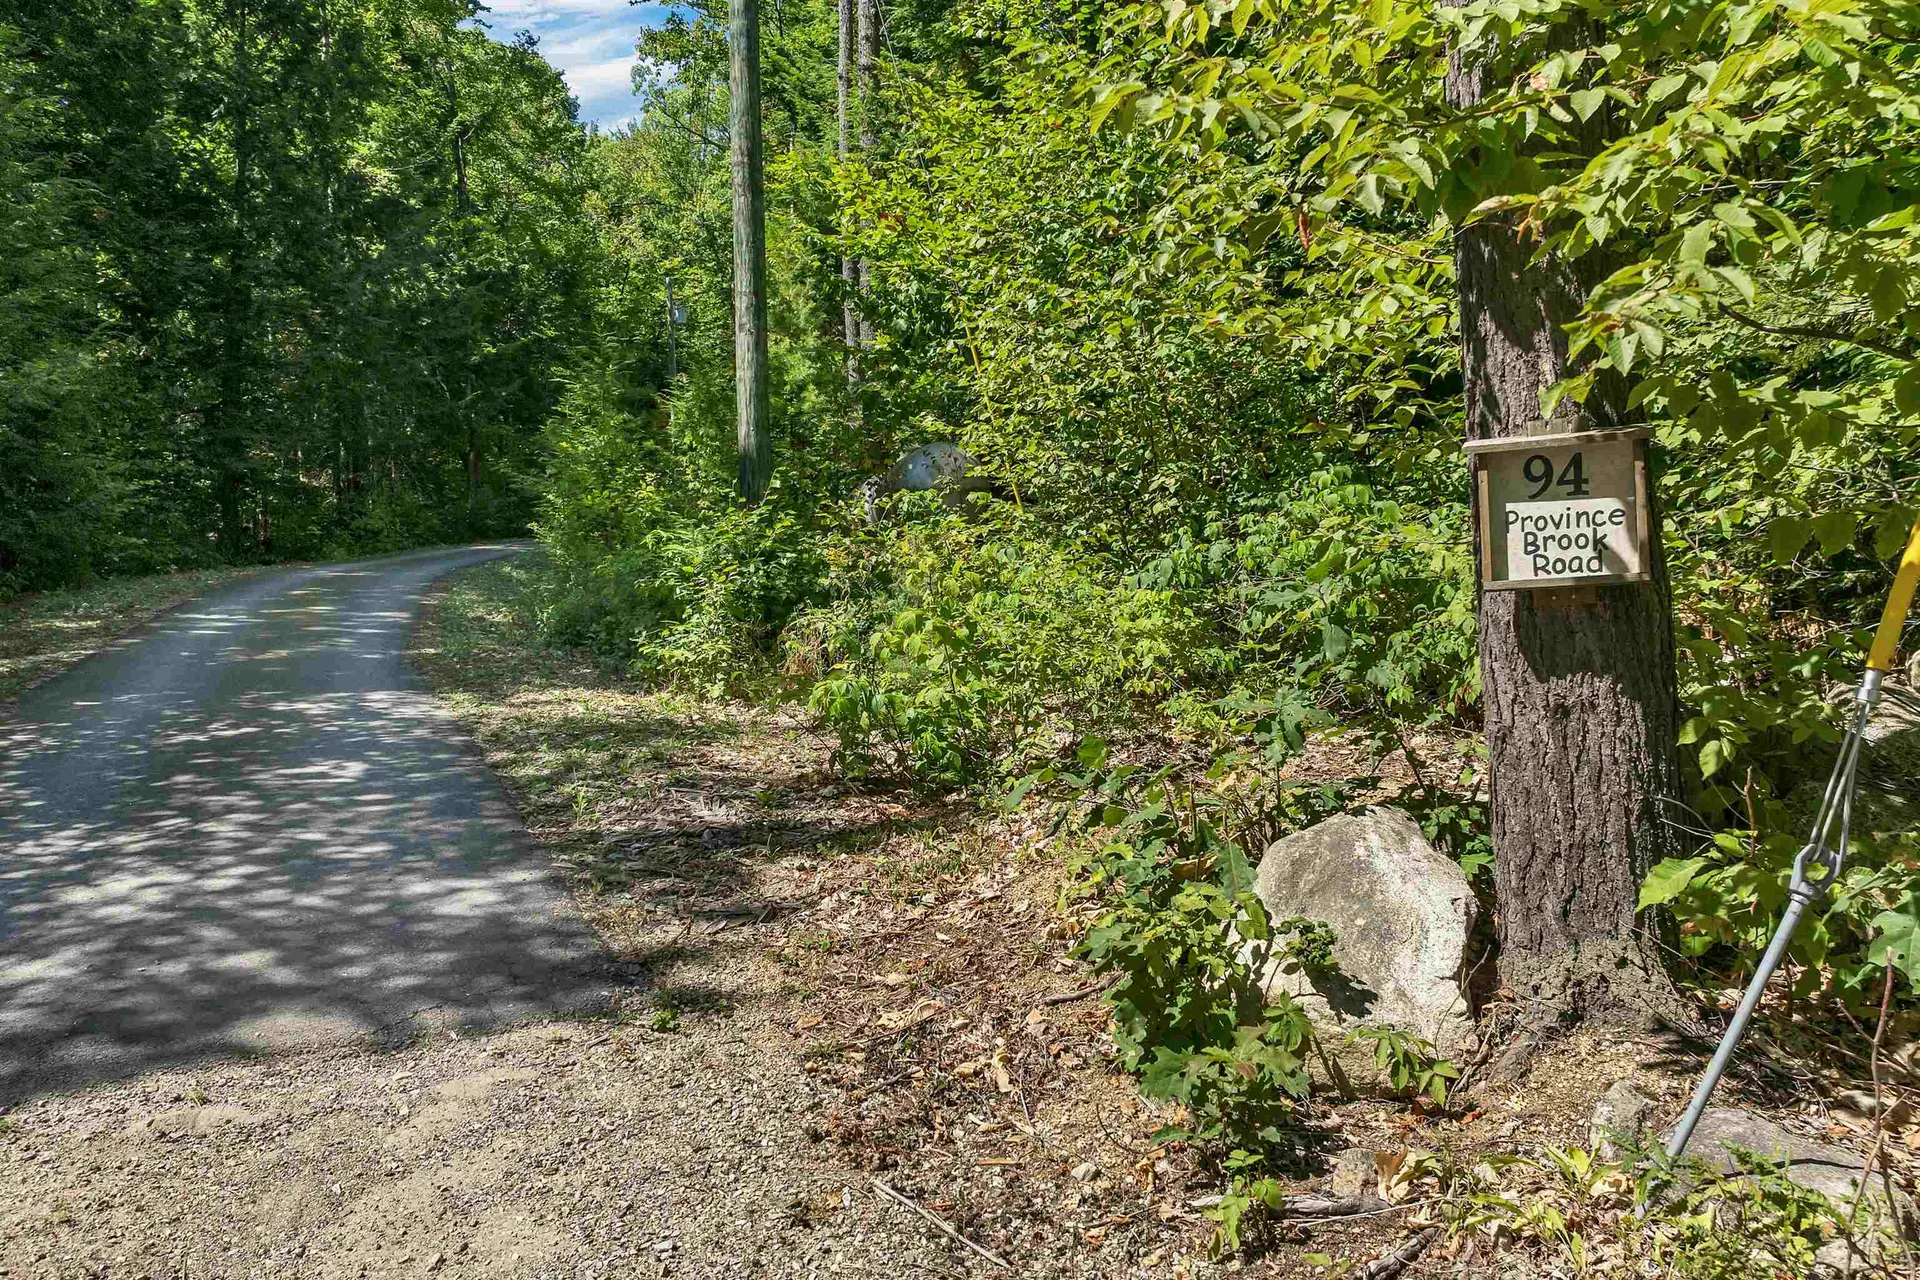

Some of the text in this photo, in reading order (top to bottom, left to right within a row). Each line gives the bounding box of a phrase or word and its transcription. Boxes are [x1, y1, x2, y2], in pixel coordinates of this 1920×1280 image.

[1523, 452, 1590, 500] 94
[1505, 507, 1626, 534] Province
[1523, 528, 1609, 556] Brook
[1533, 549, 1603, 577] Road
